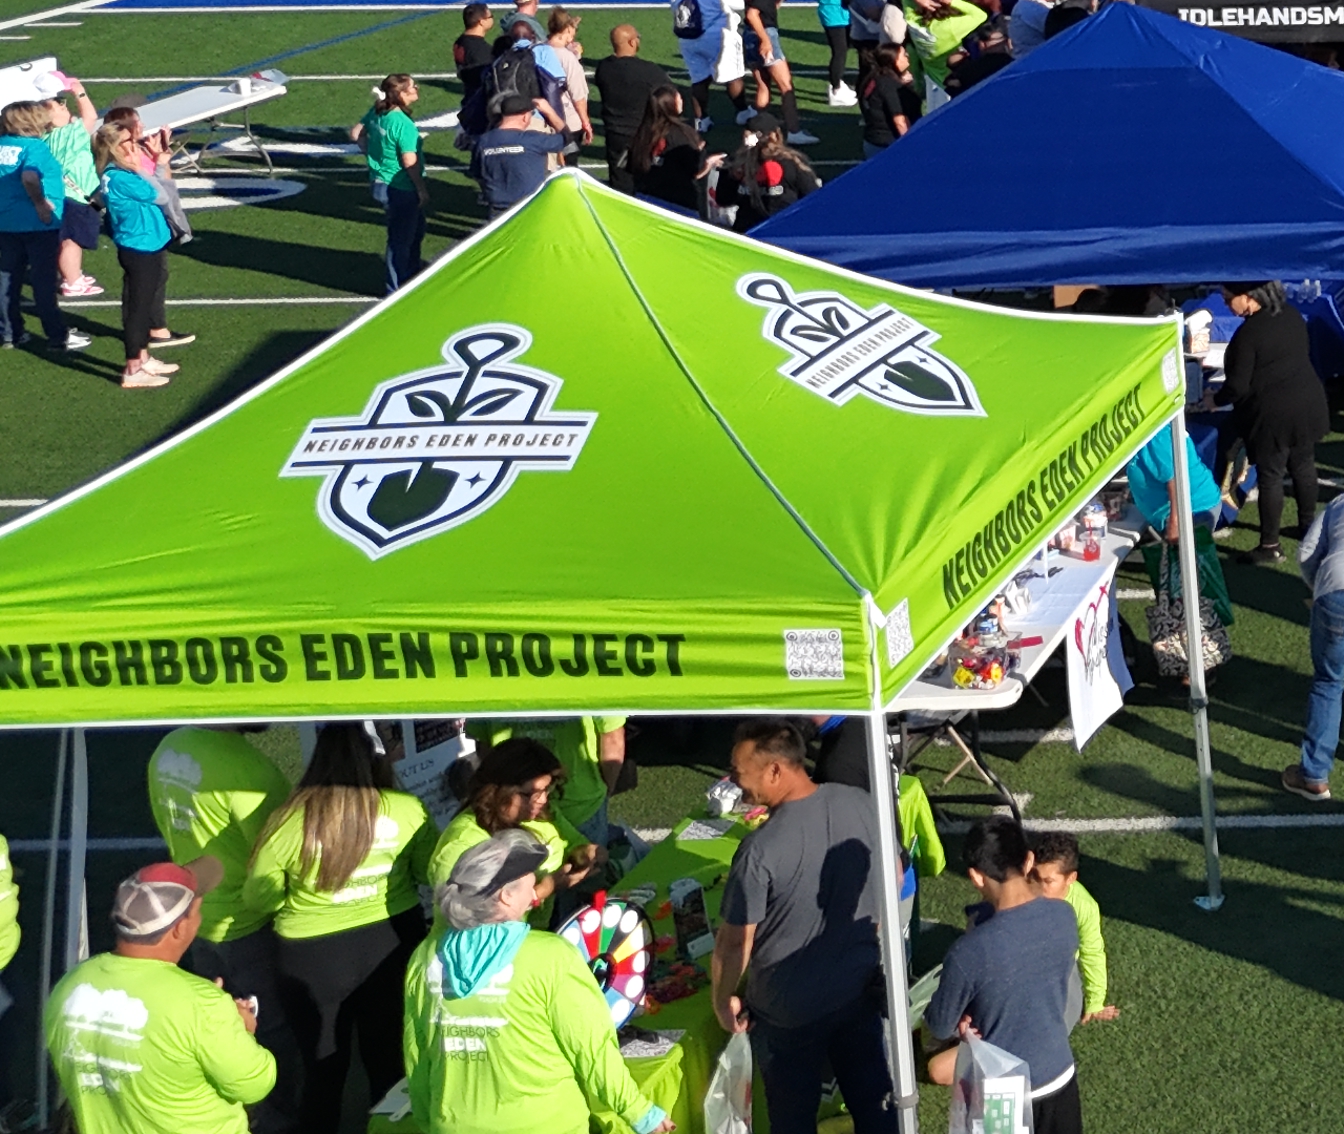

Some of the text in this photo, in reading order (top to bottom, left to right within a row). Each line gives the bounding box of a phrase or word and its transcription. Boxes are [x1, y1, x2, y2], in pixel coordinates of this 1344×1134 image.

[806, 316, 914, 389] NEIGHBORS EDEN PROJECT
[303, 433, 579, 454] NEIGHBORS EDEN PROJECT
[942, 383, 1148, 609] NEIGHBORS EDEN PROJECT
[0, 631, 687, 691] NEIGHBORS EDEN PROJECT
[440, 1026, 500, 1038] IGHBORS
[444, 1037, 486, 1052] EDEN
[81, 1073, 120, 1093] EDN
